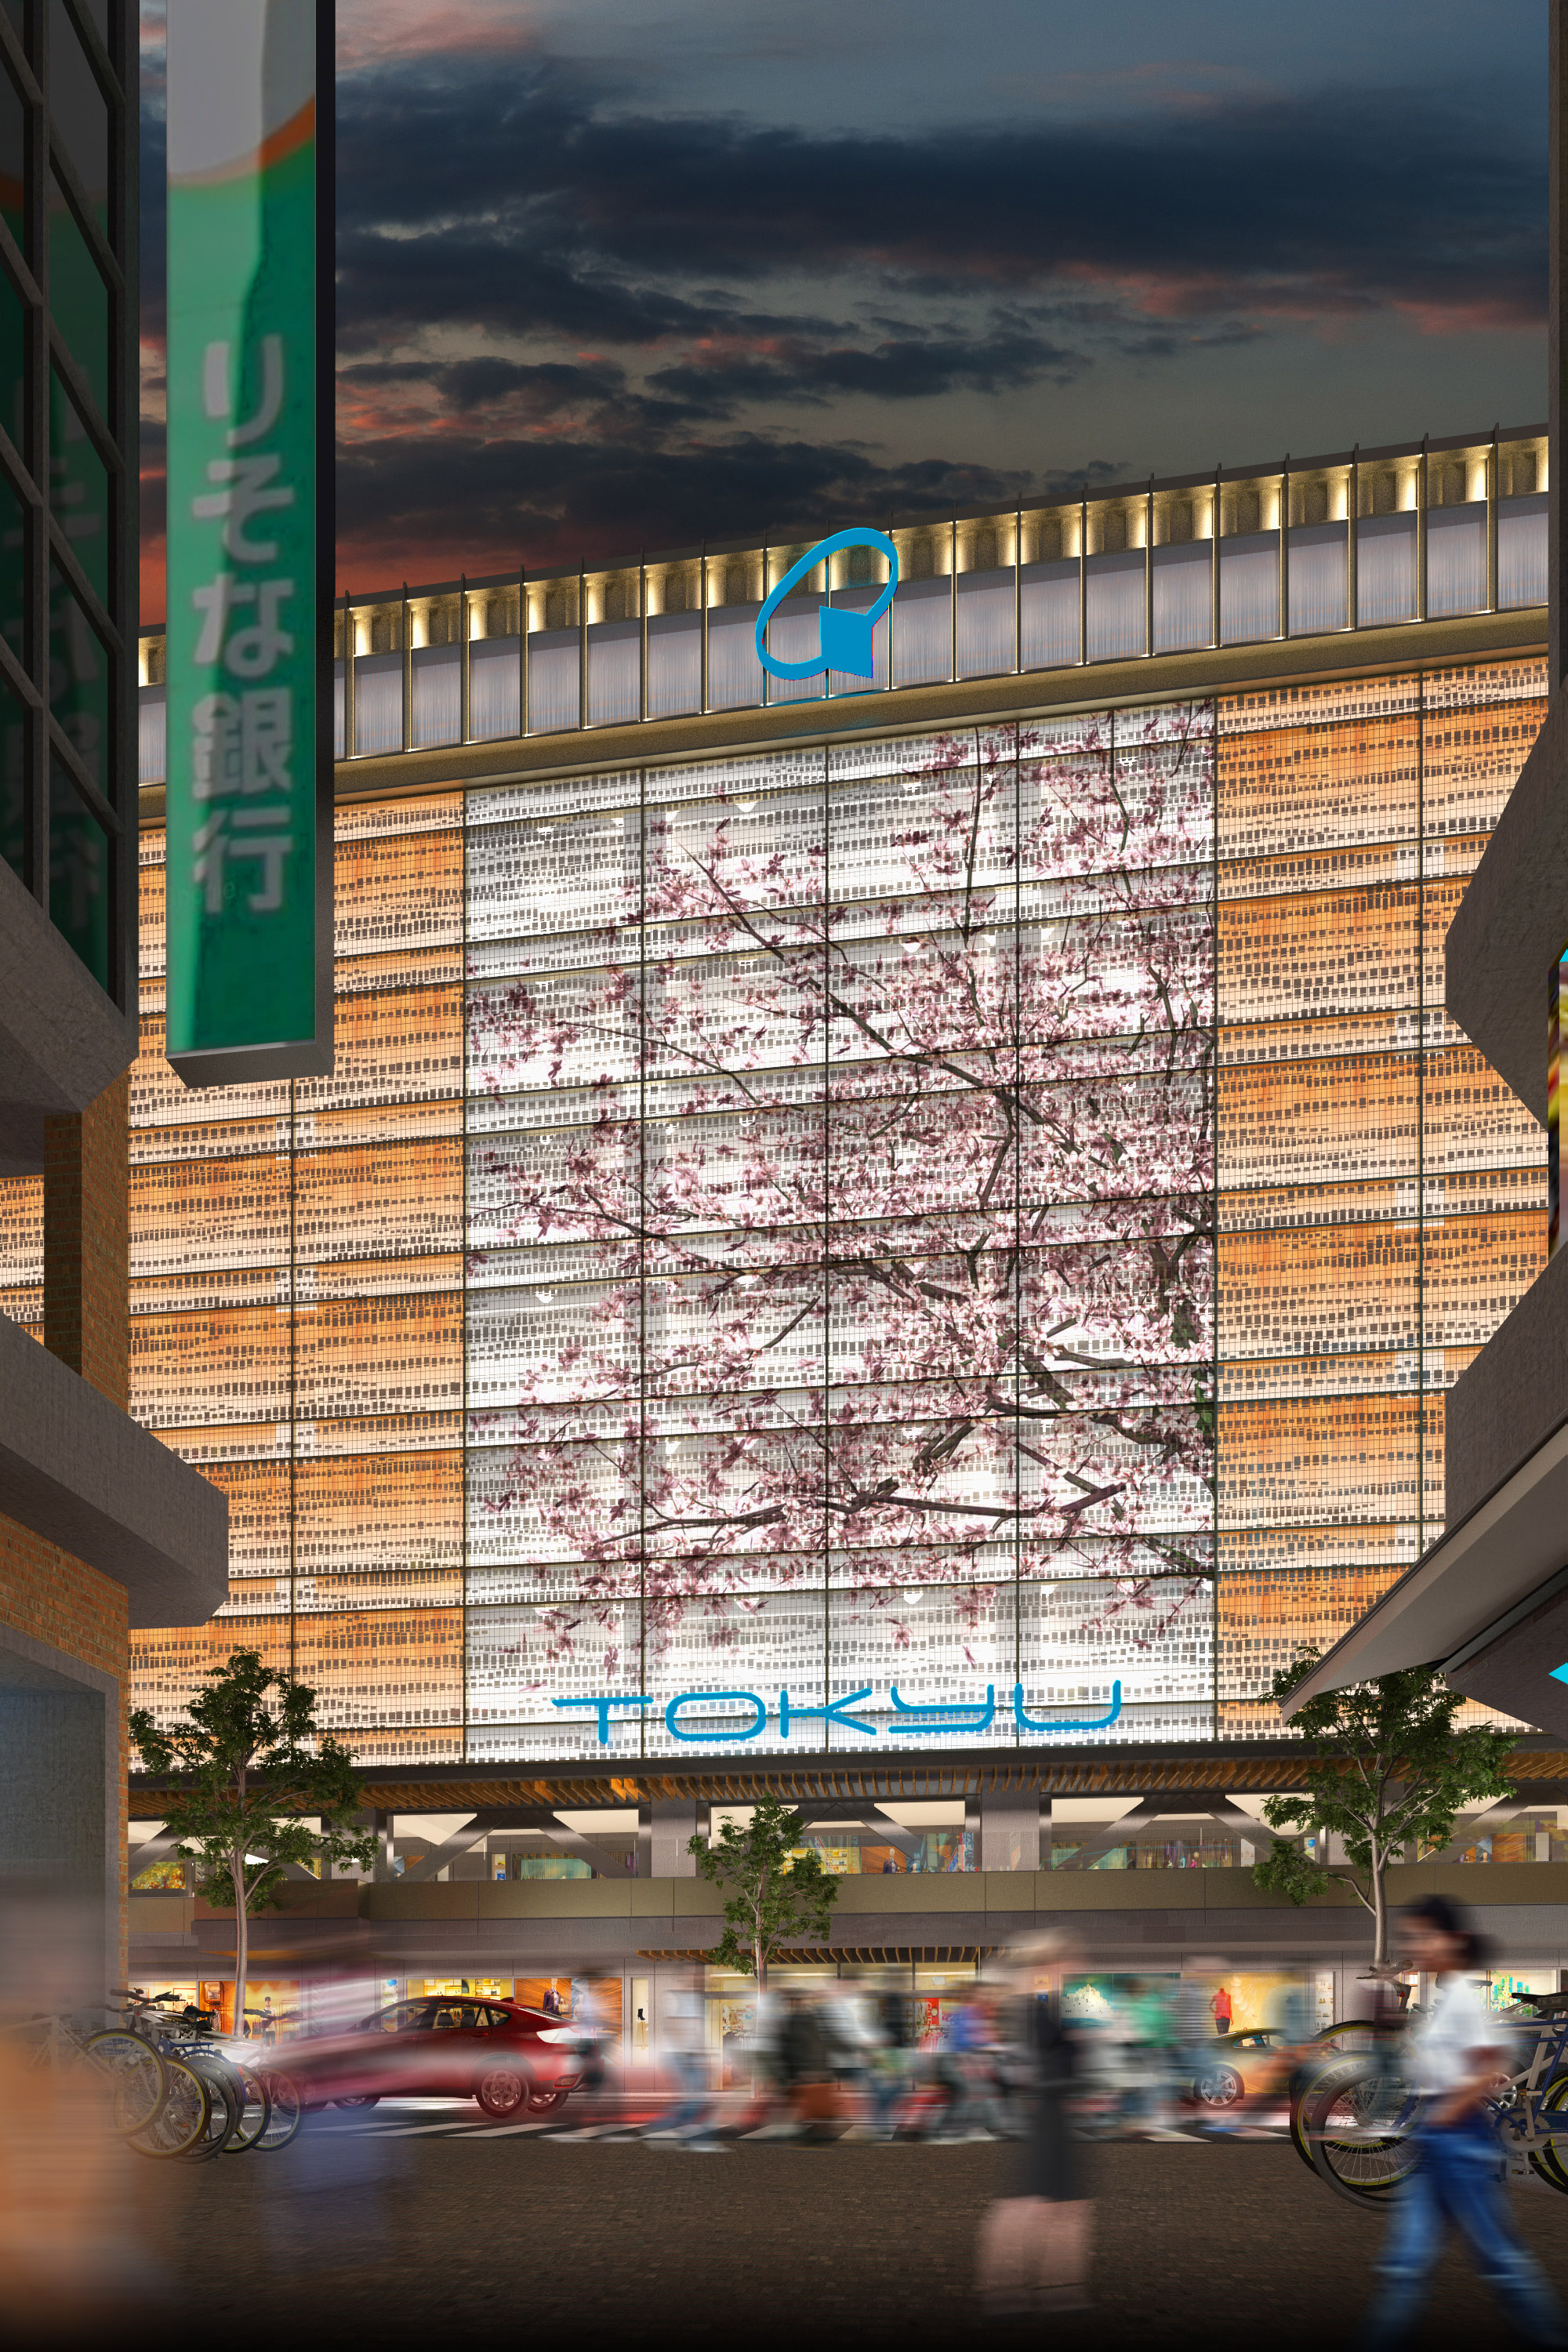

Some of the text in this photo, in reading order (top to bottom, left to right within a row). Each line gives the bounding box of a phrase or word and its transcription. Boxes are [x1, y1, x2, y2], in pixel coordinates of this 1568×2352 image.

[191, 336, 295, 914] りそな銀行
[552, 1680, 1121, 1744] TOKYU
